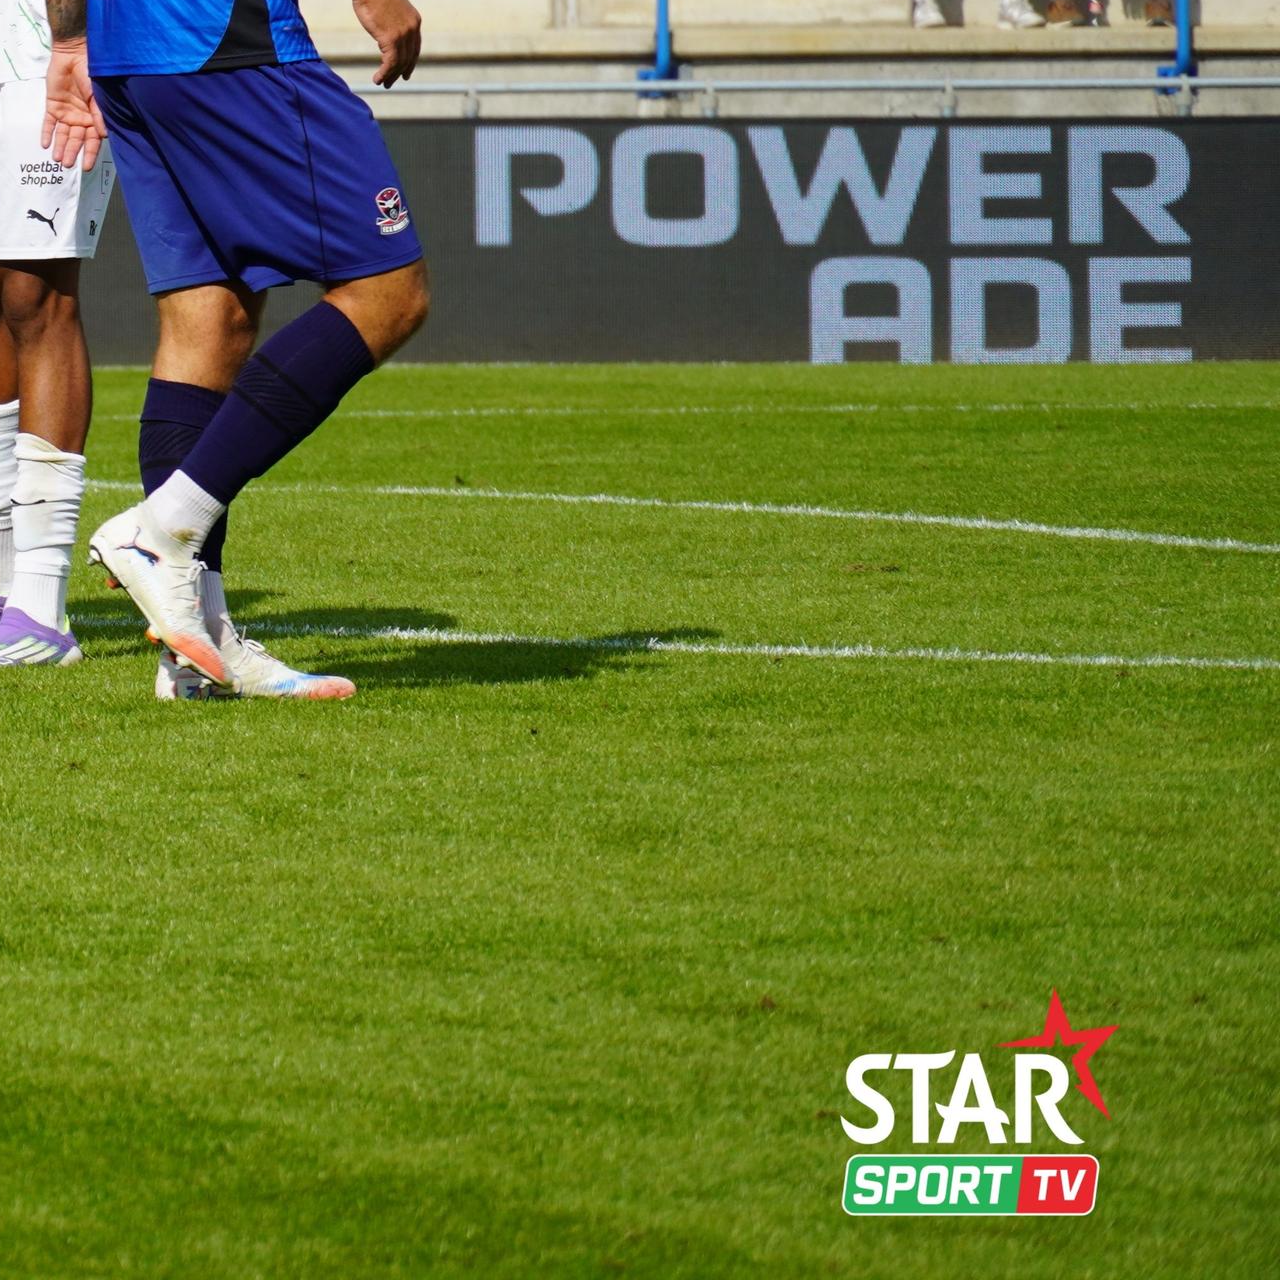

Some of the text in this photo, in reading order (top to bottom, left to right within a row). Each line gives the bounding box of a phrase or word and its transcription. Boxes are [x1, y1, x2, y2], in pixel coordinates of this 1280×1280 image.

[20, 174, 64, 187] shop.be
[475, 125, 1192, 246] POWER
[809, 256, 1193, 364] ADE
